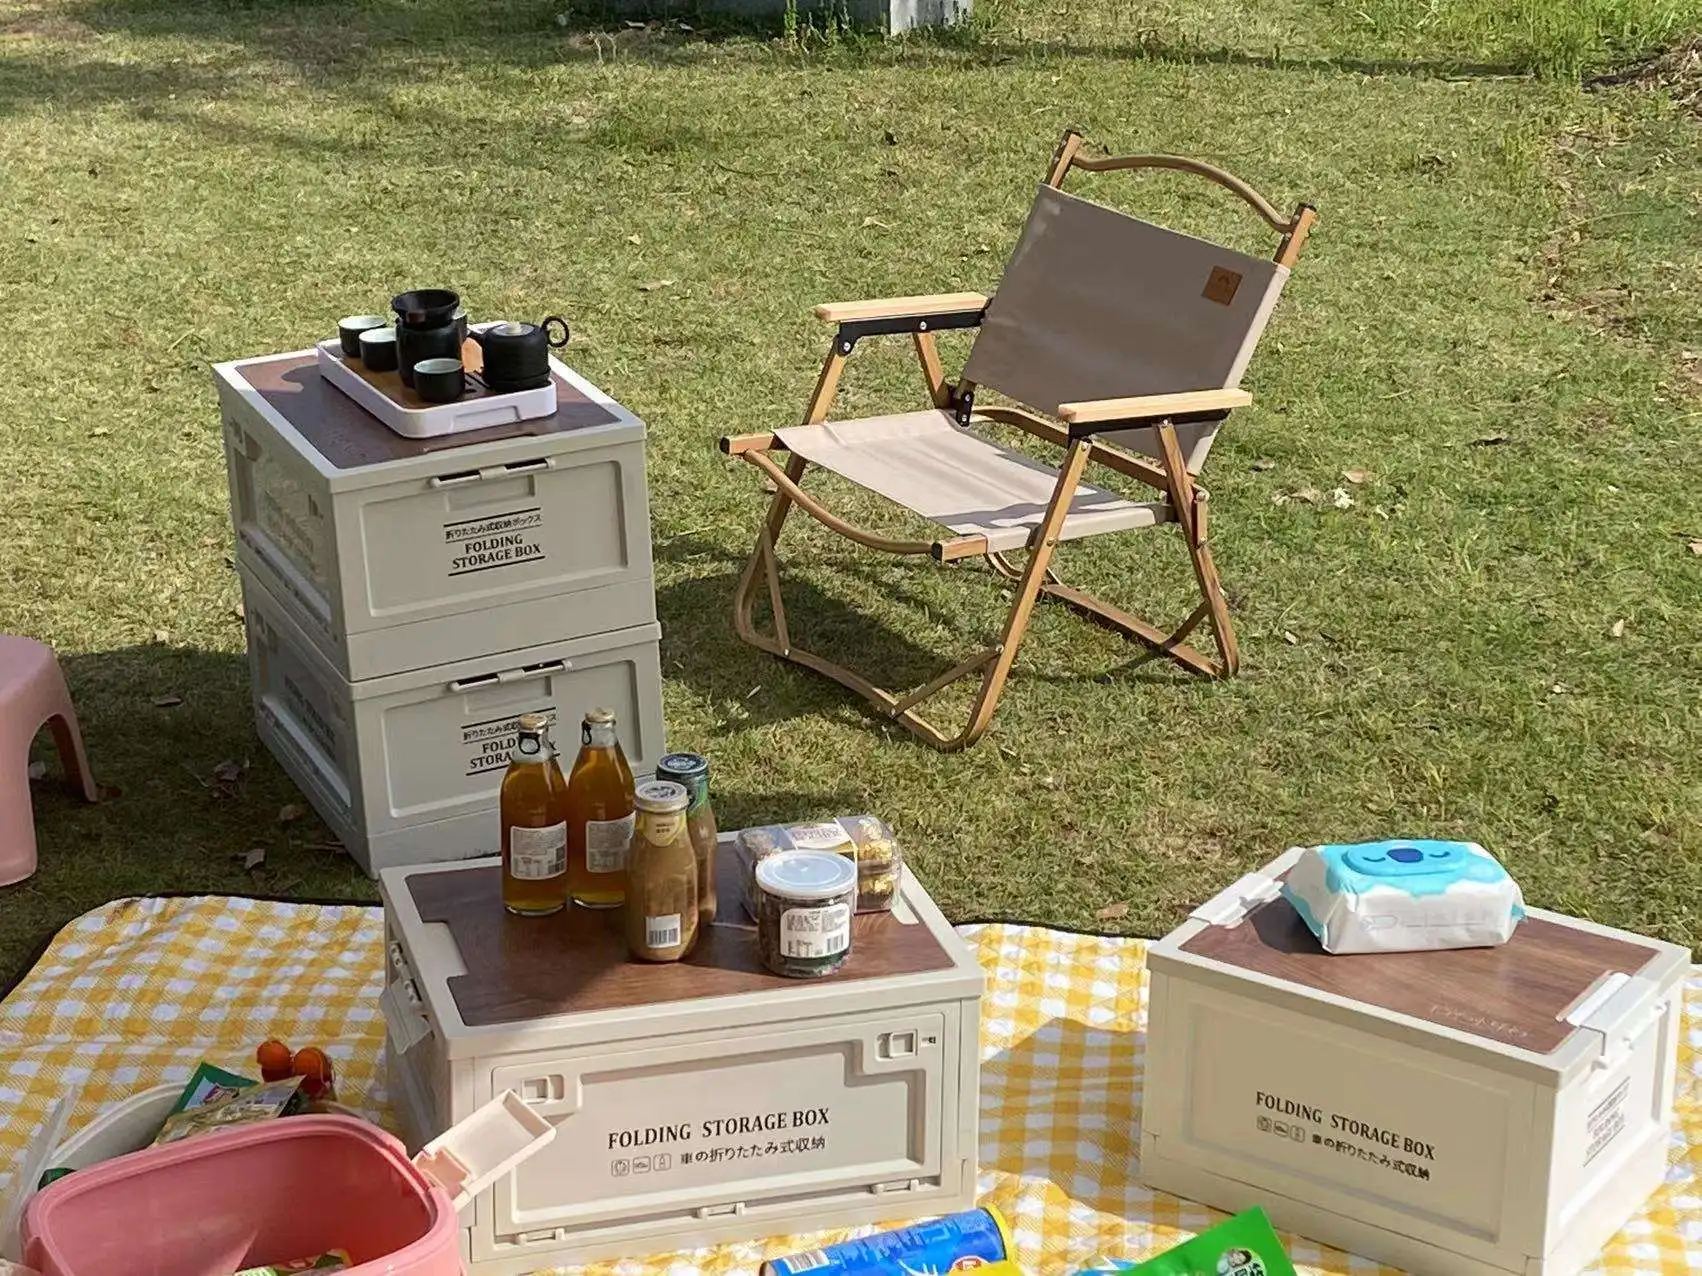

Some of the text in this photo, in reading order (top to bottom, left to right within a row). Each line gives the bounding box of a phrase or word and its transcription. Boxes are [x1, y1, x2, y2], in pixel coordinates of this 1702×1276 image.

[452, 543, 541, 569] STORAGE BOX
[464, 533, 523, 554] FOLDING
[482, 737, 517, 754] FOLD
[470, 750, 514, 769] STORA
[608, 1108, 830, 1150] FOLDING STORAGE BOX
[1256, 1091, 1436, 1161] FOLDING STORAGE BOX
[680, 1136, 826, 1165] 車の折りたたみ式収納
